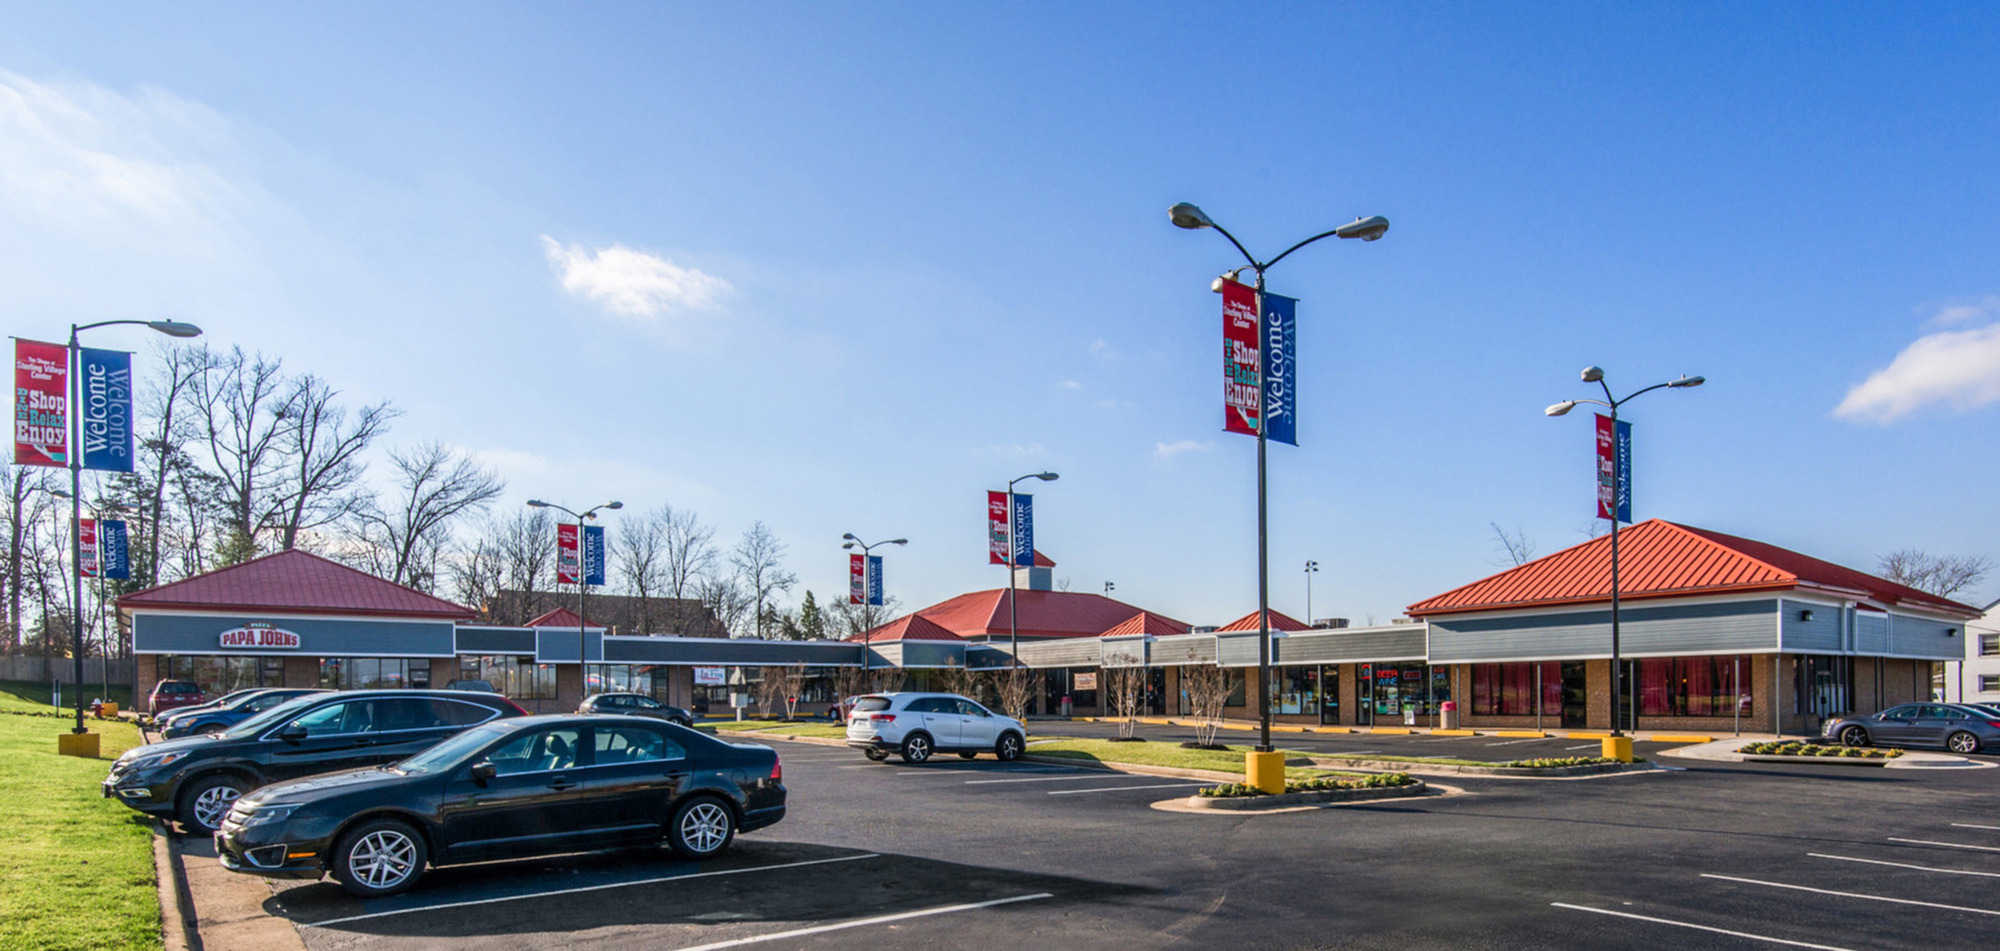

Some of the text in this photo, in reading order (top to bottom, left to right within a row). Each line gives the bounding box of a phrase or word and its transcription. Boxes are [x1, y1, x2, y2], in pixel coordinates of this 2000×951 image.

[1233, 318, 1250, 329] Center
[16, 360, 66, 376] Sterling Village
[1224, 338, 1234, 376] DINE
[1266, 312, 1284, 419] Welcome
[31, 372, 52, 380] Center
[1283, 320, 1295, 424] Welcome
[29, 390, 65, 414] Shop
[1226, 376, 1258, 407] Enjoy
[29, 410, 65, 427] Relax
[85, 363, 108, 454] Welcome
[108, 368, 130, 457] Welcome
[16, 420, 65, 444] Enjoy
[1016, 502, 1024, 555] Welcome
[105, 526, 117, 570] Welcome
[584, 532, 595, 576] Welcome
[223, 630, 298, 646] PAPA JOHNS
[1376, 669, 1398, 678] BEER
[1377, 677, 1397, 685] WINE
